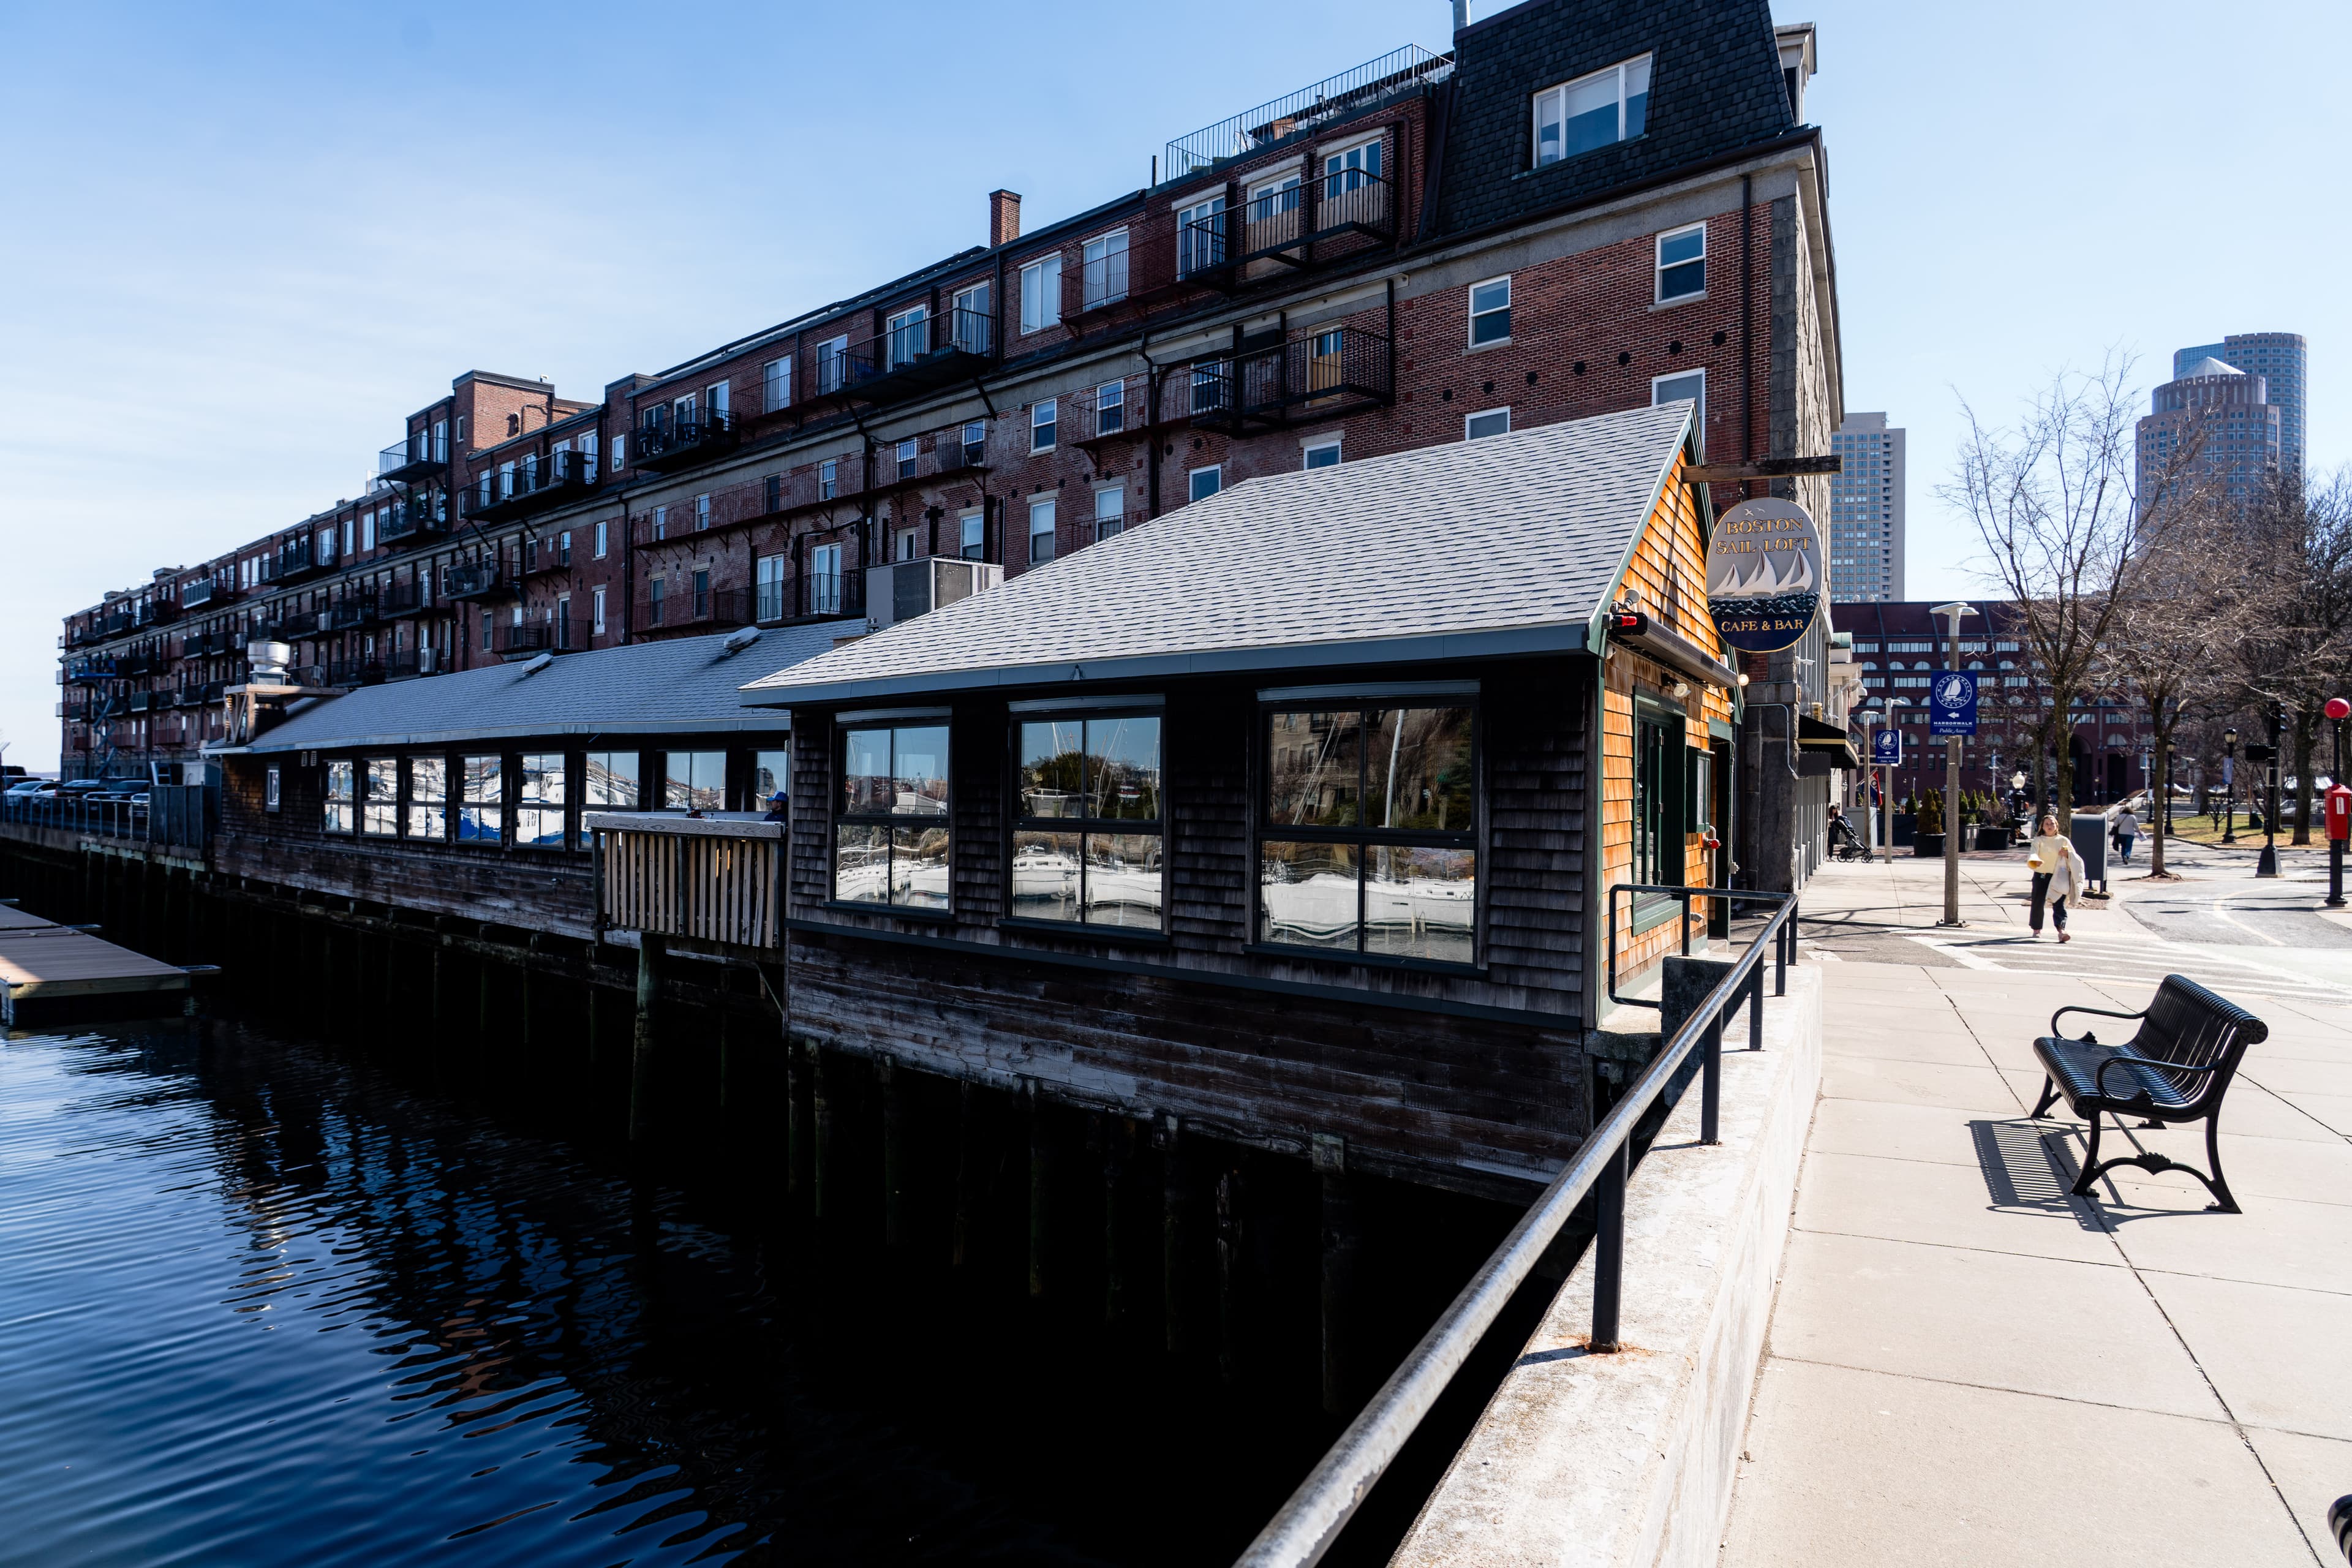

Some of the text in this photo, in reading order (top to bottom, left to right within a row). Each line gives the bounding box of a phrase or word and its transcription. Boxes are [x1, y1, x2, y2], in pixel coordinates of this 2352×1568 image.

[1725, 518, 1803, 535] BOSTON
[1716, 537, 1811, 554] SAIL LOFT
[1721, 619, 1804, 633] CAFE & BAR
